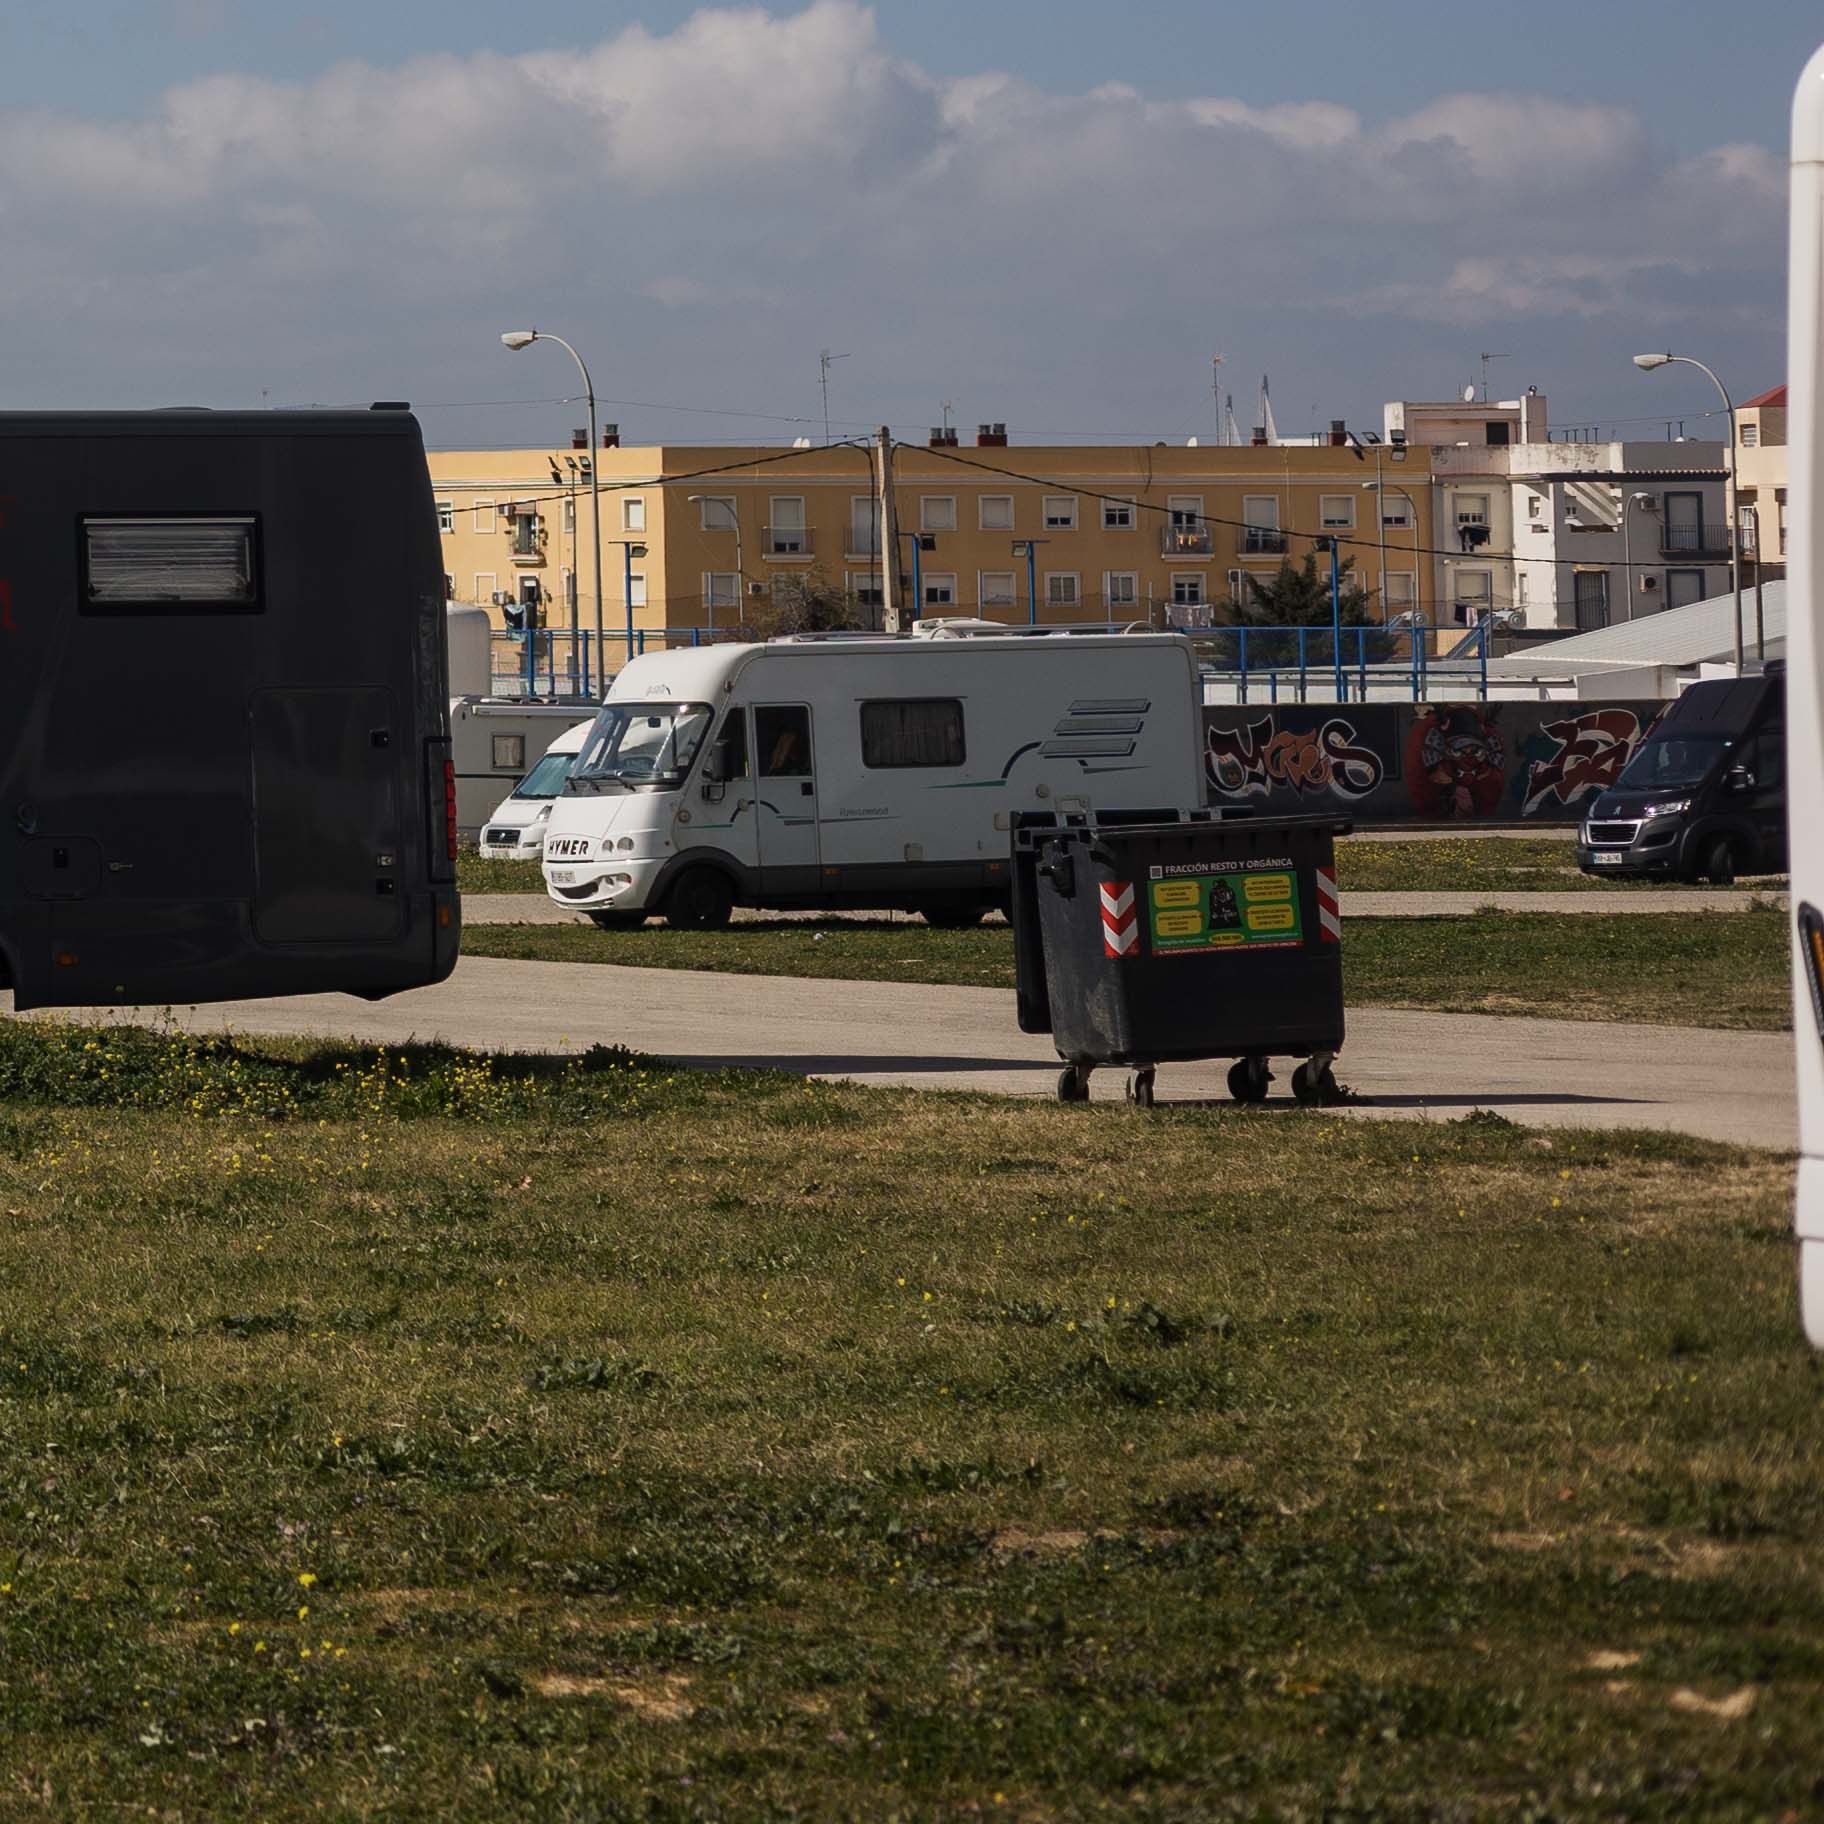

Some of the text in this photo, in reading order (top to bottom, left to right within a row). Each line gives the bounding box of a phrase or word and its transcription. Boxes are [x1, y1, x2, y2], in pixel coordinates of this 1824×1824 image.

[548, 839, 589, 855] HYMER
[1165, 857, 1294, 874] FRACCIÓN RESTO Y ORGÁNICA
